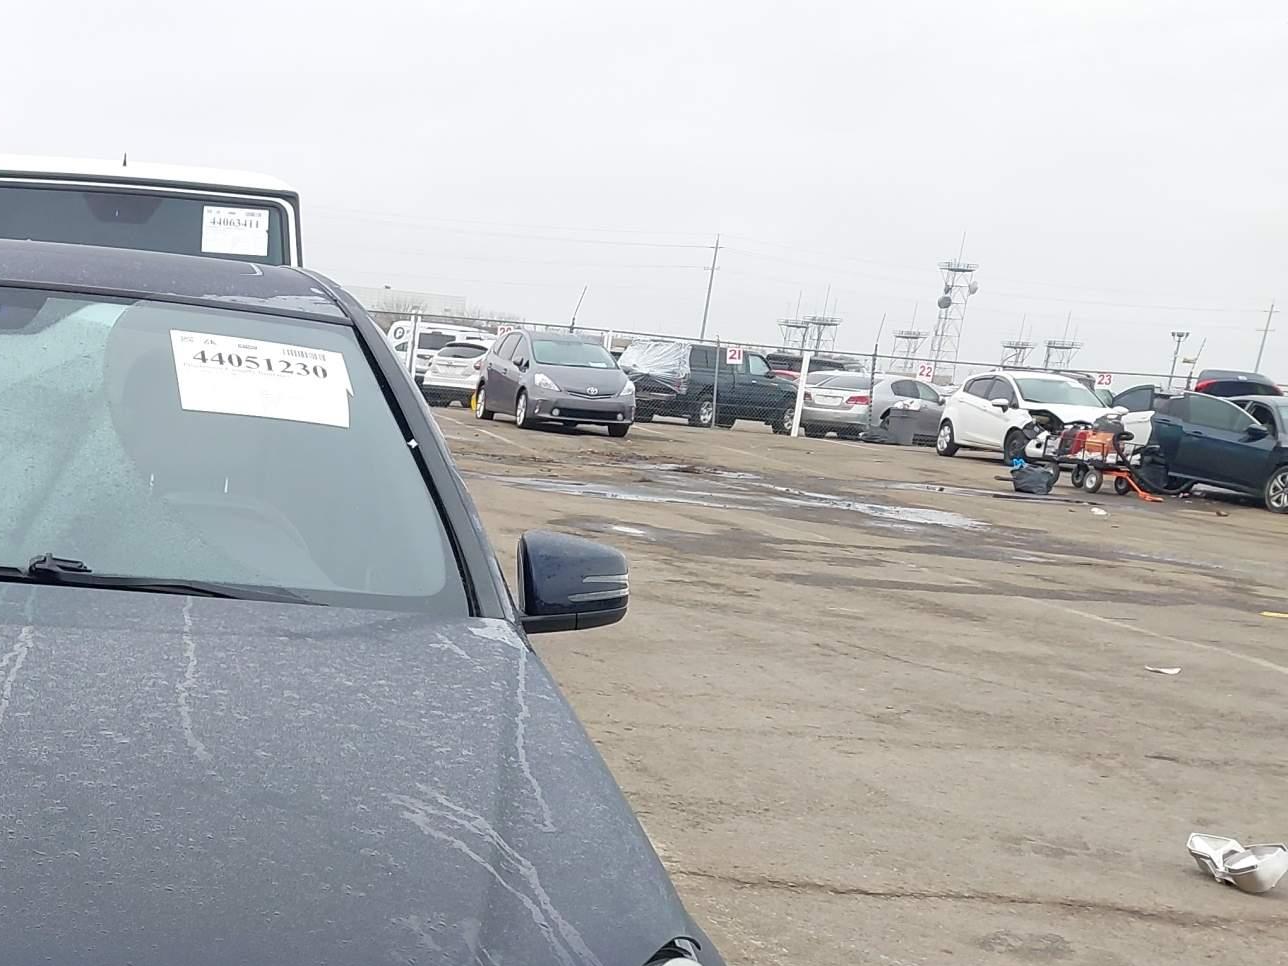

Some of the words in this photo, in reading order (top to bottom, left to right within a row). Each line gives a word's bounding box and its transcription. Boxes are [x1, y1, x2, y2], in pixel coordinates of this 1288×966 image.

[210, 217, 259, 229] 44063411
[728, 349, 741, 360] 21
[192, 349, 328, 379] 44051230
[919, 365, 933, 377] 22
[1097, 374, 1112, 385] 23
